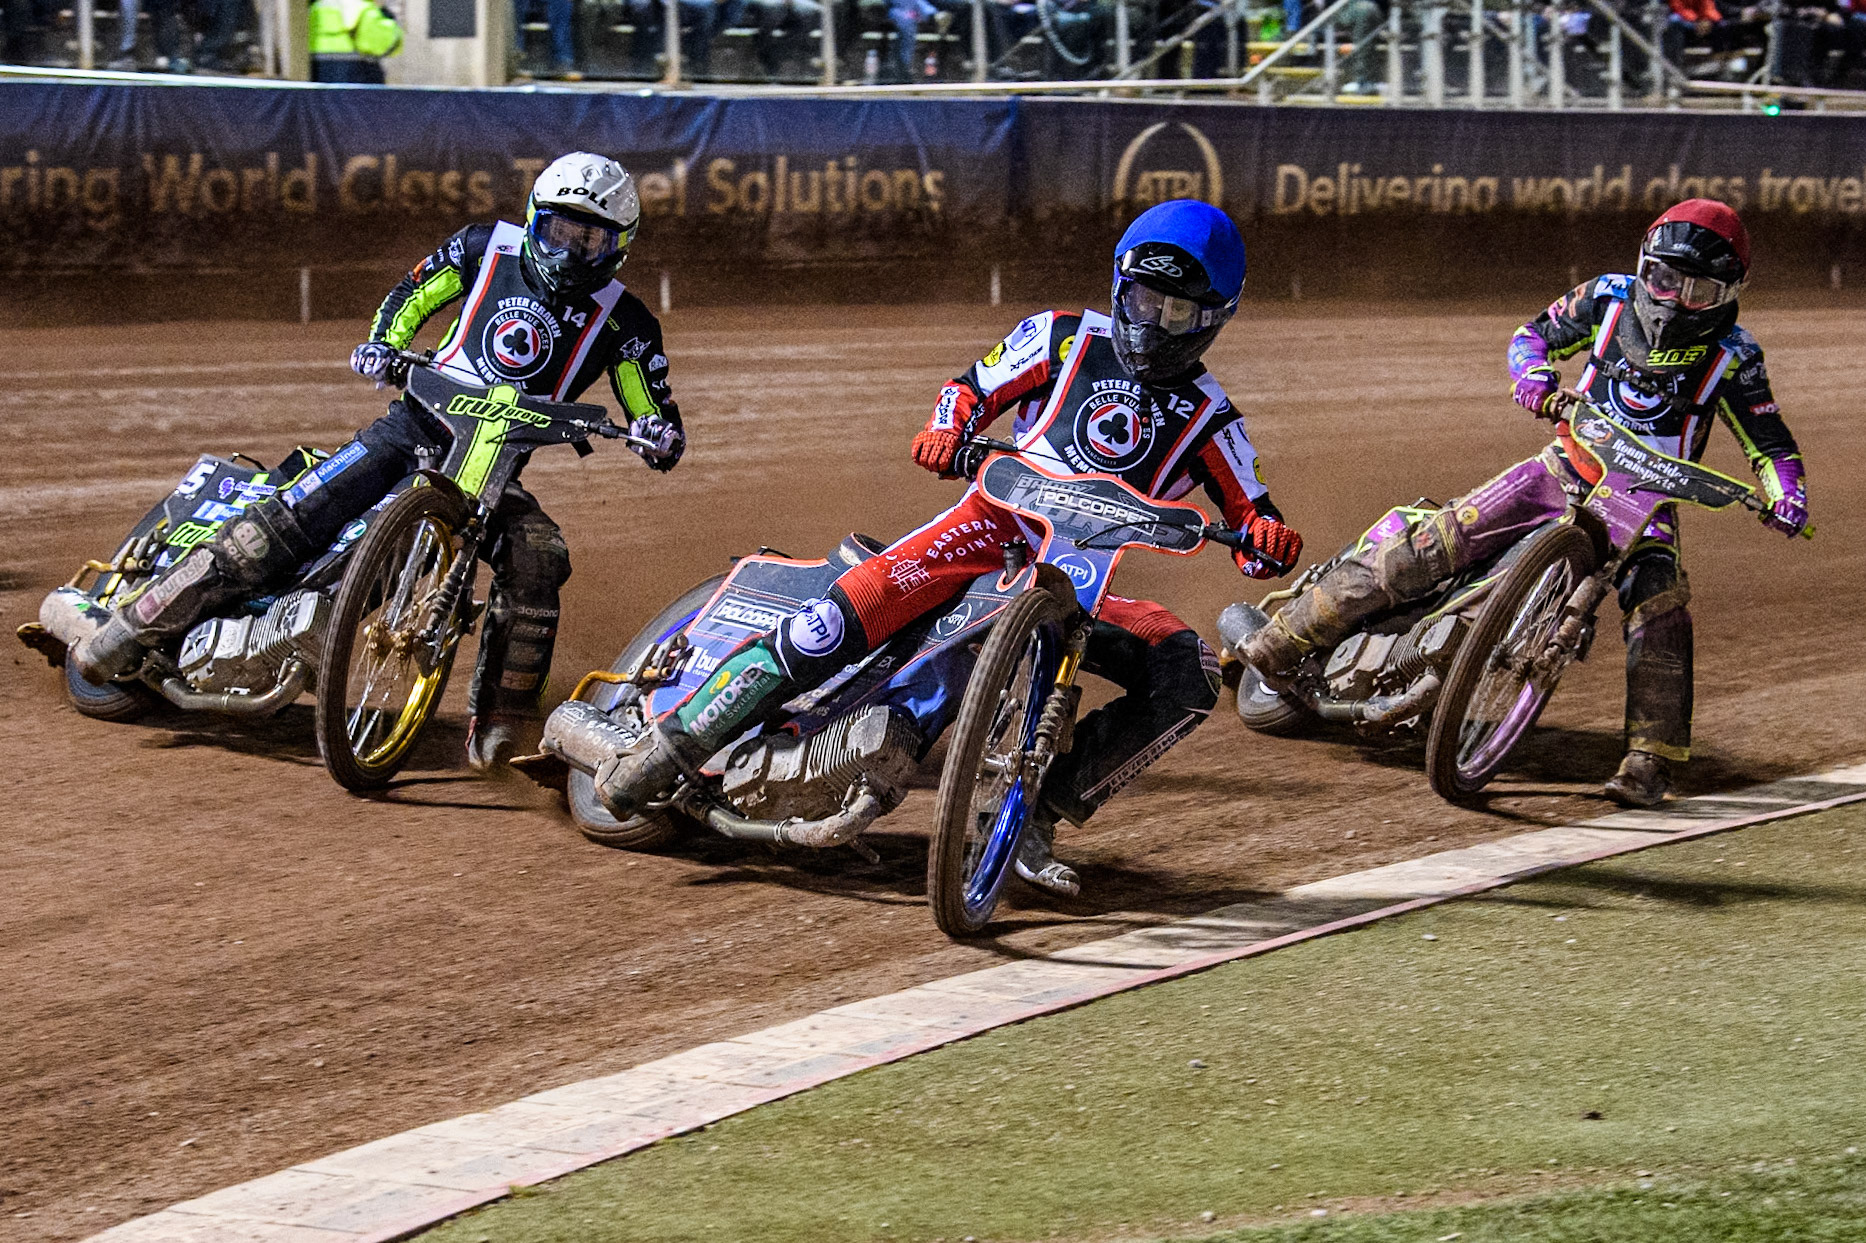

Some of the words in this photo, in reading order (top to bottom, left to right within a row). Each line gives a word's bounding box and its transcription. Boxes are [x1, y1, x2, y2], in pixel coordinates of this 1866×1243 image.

[141, 152, 318, 213] World
[338, 153, 496, 215] Class
[706, 155, 945, 214] Solutions
[556, 186, 608, 211] BOLL
[1274, 162, 1499, 216] Delivering
[1512, 164, 1633, 213] world
[494, 311, 520, 327] BELLE
[522, 312, 540, 327] VUE
[537, 327, 550, 351] ACES
[497, 296, 530, 310] PETER
[529, 302, 562, 338] CRAVEN
[562, 305, 588, 329] 14
[1091, 379, 1130, 392] PETER
[1088, 394, 1119, 411] BELLE
[1123, 396, 1140, 412] VUE
[1166, 393, 1196, 420] 12
[177, 462, 217, 495] 5
[302, 476, 316, 489] Ice
[318, 445, 362, 479] Machines
[926, 518, 998, 560] EASTERN
[944, 533, 995, 562] POINT
[1060, 562, 1089, 580] ATPI
